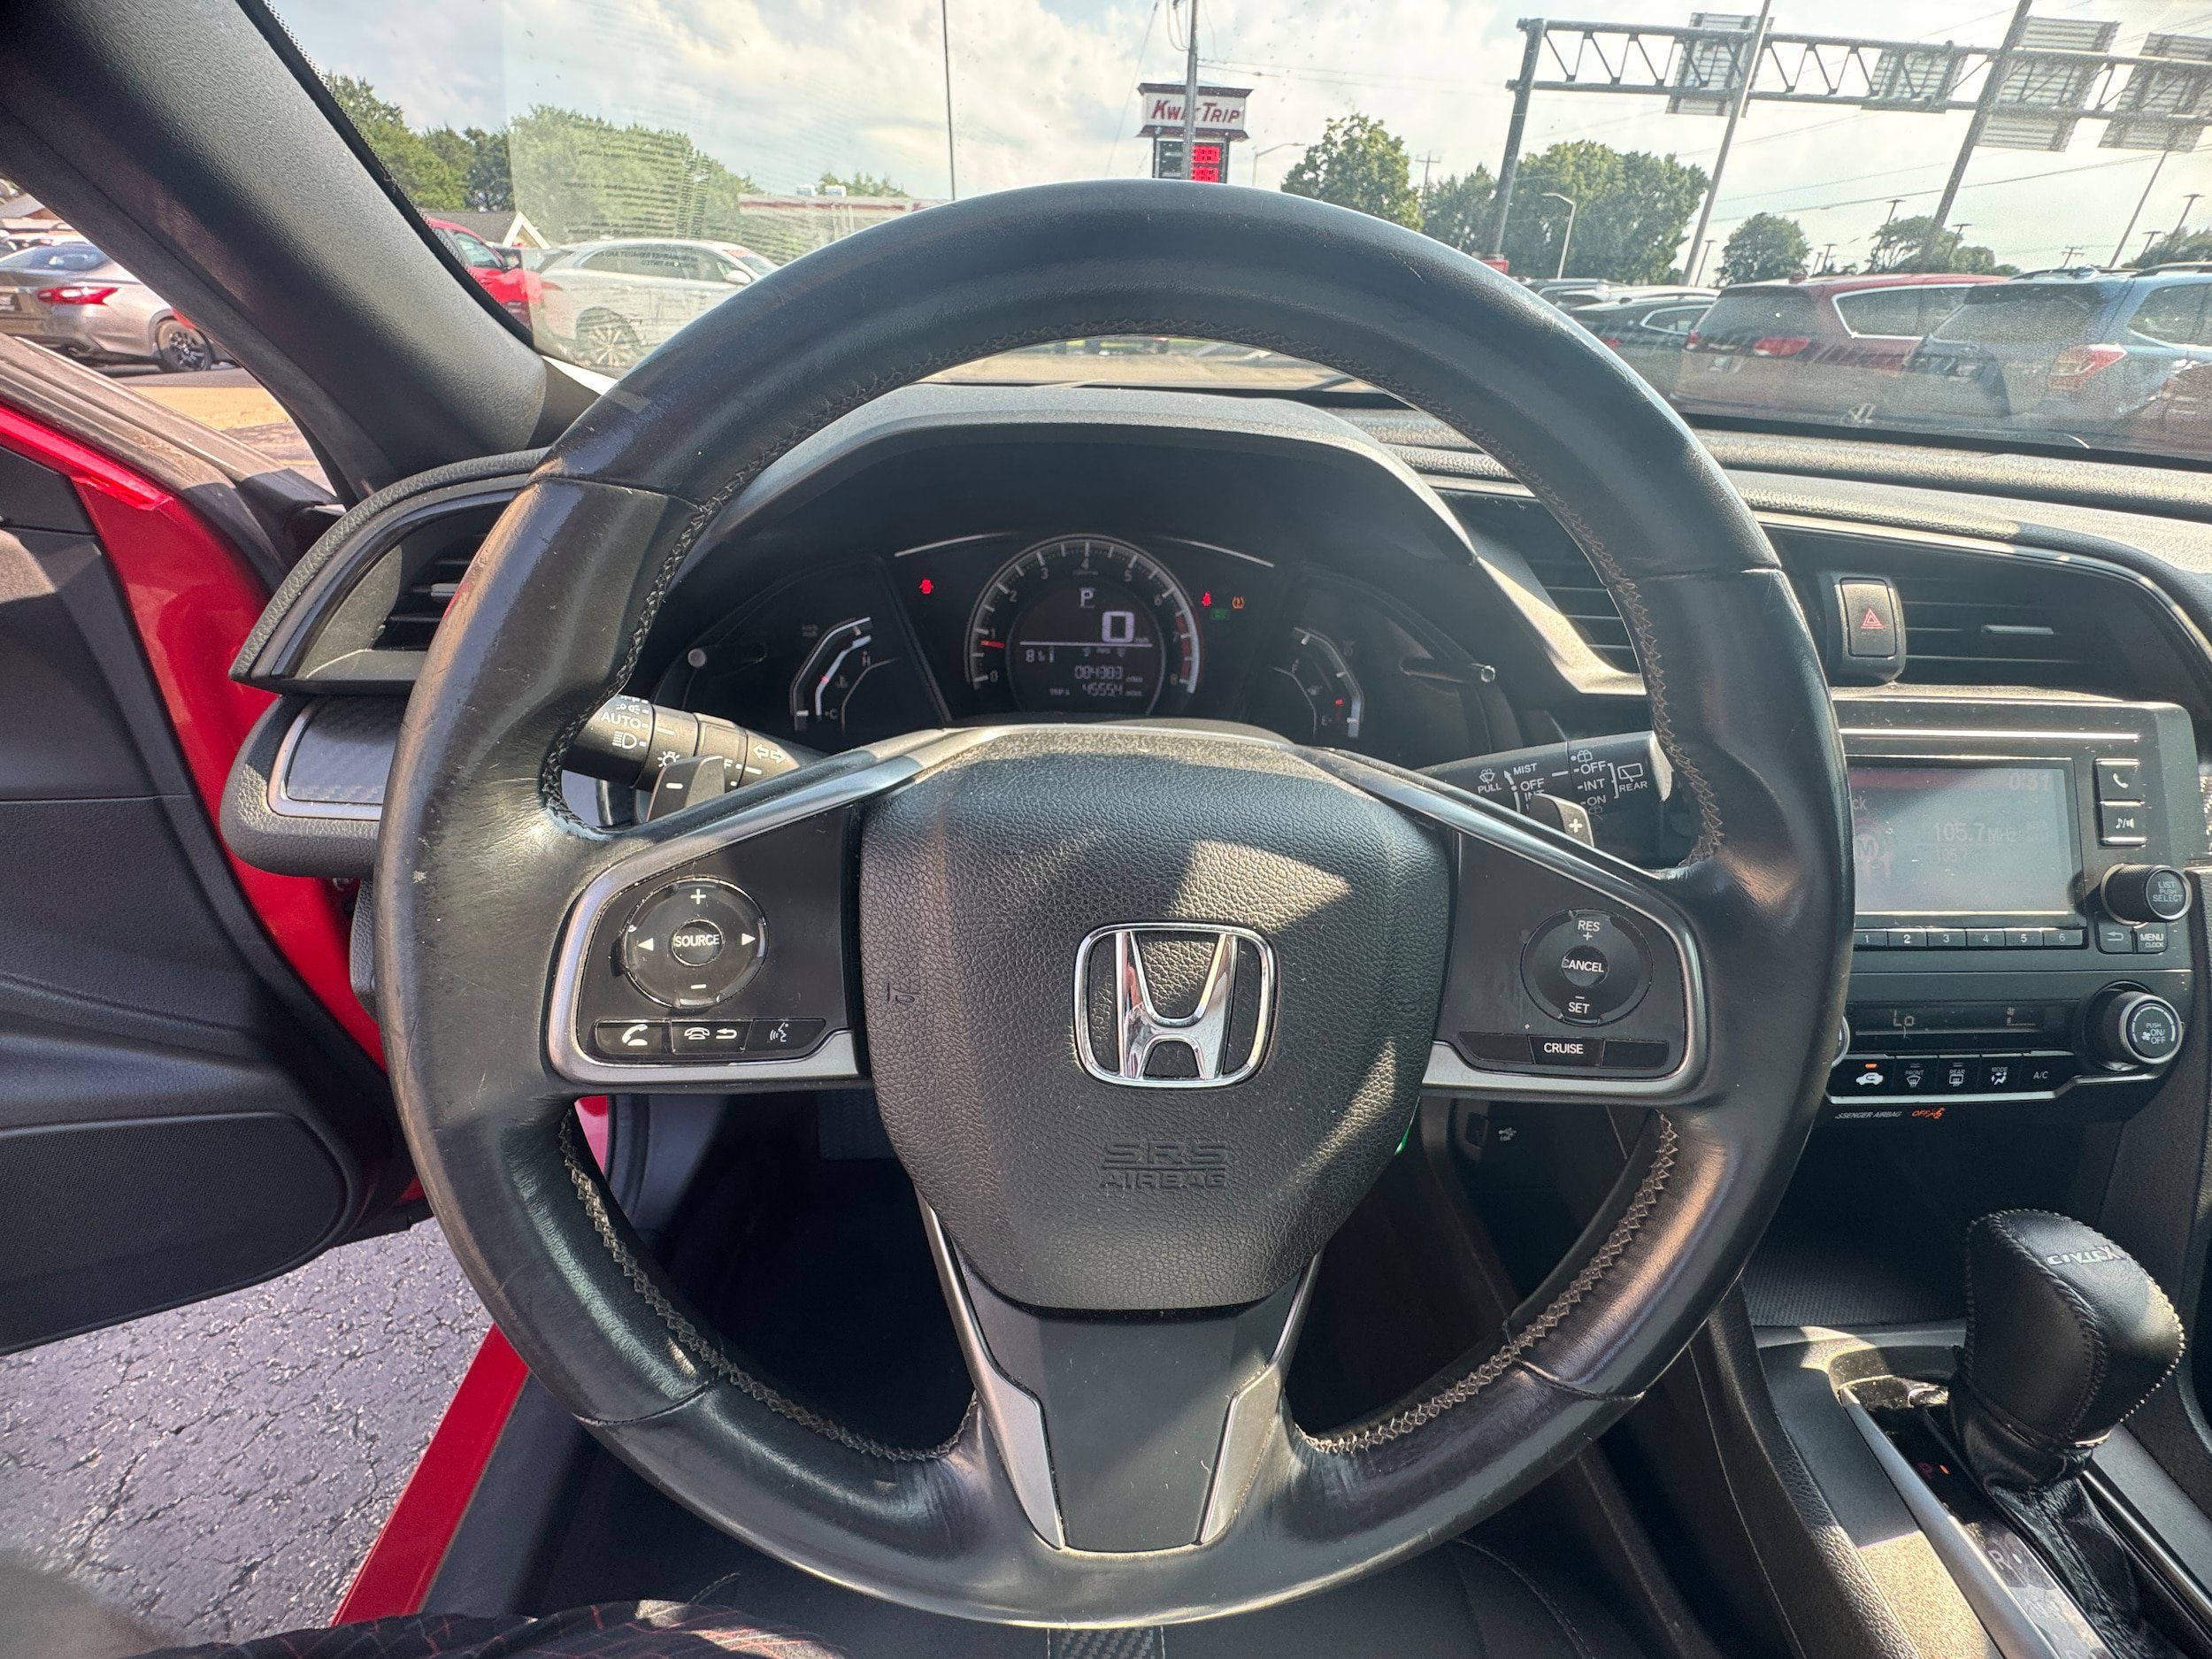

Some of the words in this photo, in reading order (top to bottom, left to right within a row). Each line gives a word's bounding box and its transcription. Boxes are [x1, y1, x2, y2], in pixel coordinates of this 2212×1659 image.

[1201, 102, 1240, 124] TRIP
[1080, 557, 1090, 569] 4
[1040, 567, 1049, 580] 3
[1124, 569, 1133, 582] 5
[1009, 589, 1018, 603] 2
[1079, 588, 1094, 608] P
[1153, 594, 1164, 606] 6
[1102, 611, 1134, 643] 0
[601, 711, 641, 730] AUTO
[1512, 762, 1538, 775] MIST
[1580, 760, 1607, 775] OFF
[1477, 782, 1502, 795] PULL
[1520, 777, 1545, 792] OFF
[1583, 778, 1606, 791] INT
[1618, 780, 1647, 793] REAR
[1586, 794, 1607, 808] ON
[1932, 821, 1986, 843] 105.7
[2157, 880, 2176, 889] LIST
[2152, 894, 2184, 902] SELECT
[1577, 919, 1601, 933] RES
[673, 934, 720, 948] SOURCE
[1864, 933, 1870, 944] 1
[1903, 933, 1912, 945] 2
[1942, 933, 1951, 944] 3
[1982, 933, 1990, 944] 4
[2020, 933, 2029, 944] 5
[2058, 933, 2066, 943] 6
[2139, 933, 2164, 941] MENU
[1561, 957, 1605, 974] CANCEL
[1568, 1002, 1590, 1015] SET
[2150, 1036, 2167, 1045] OFF
[1543, 1041, 1584, 1055] CRUISE
[2032, 1071, 2049, 1080] A/C
[1873, 1110, 1903, 1119] AIRBAG
[1911, 1109, 1931, 1118] OFF
[1102, 1141, 1227, 1165] SRS
[1100, 1171, 1228, 1190] AIRBAG
